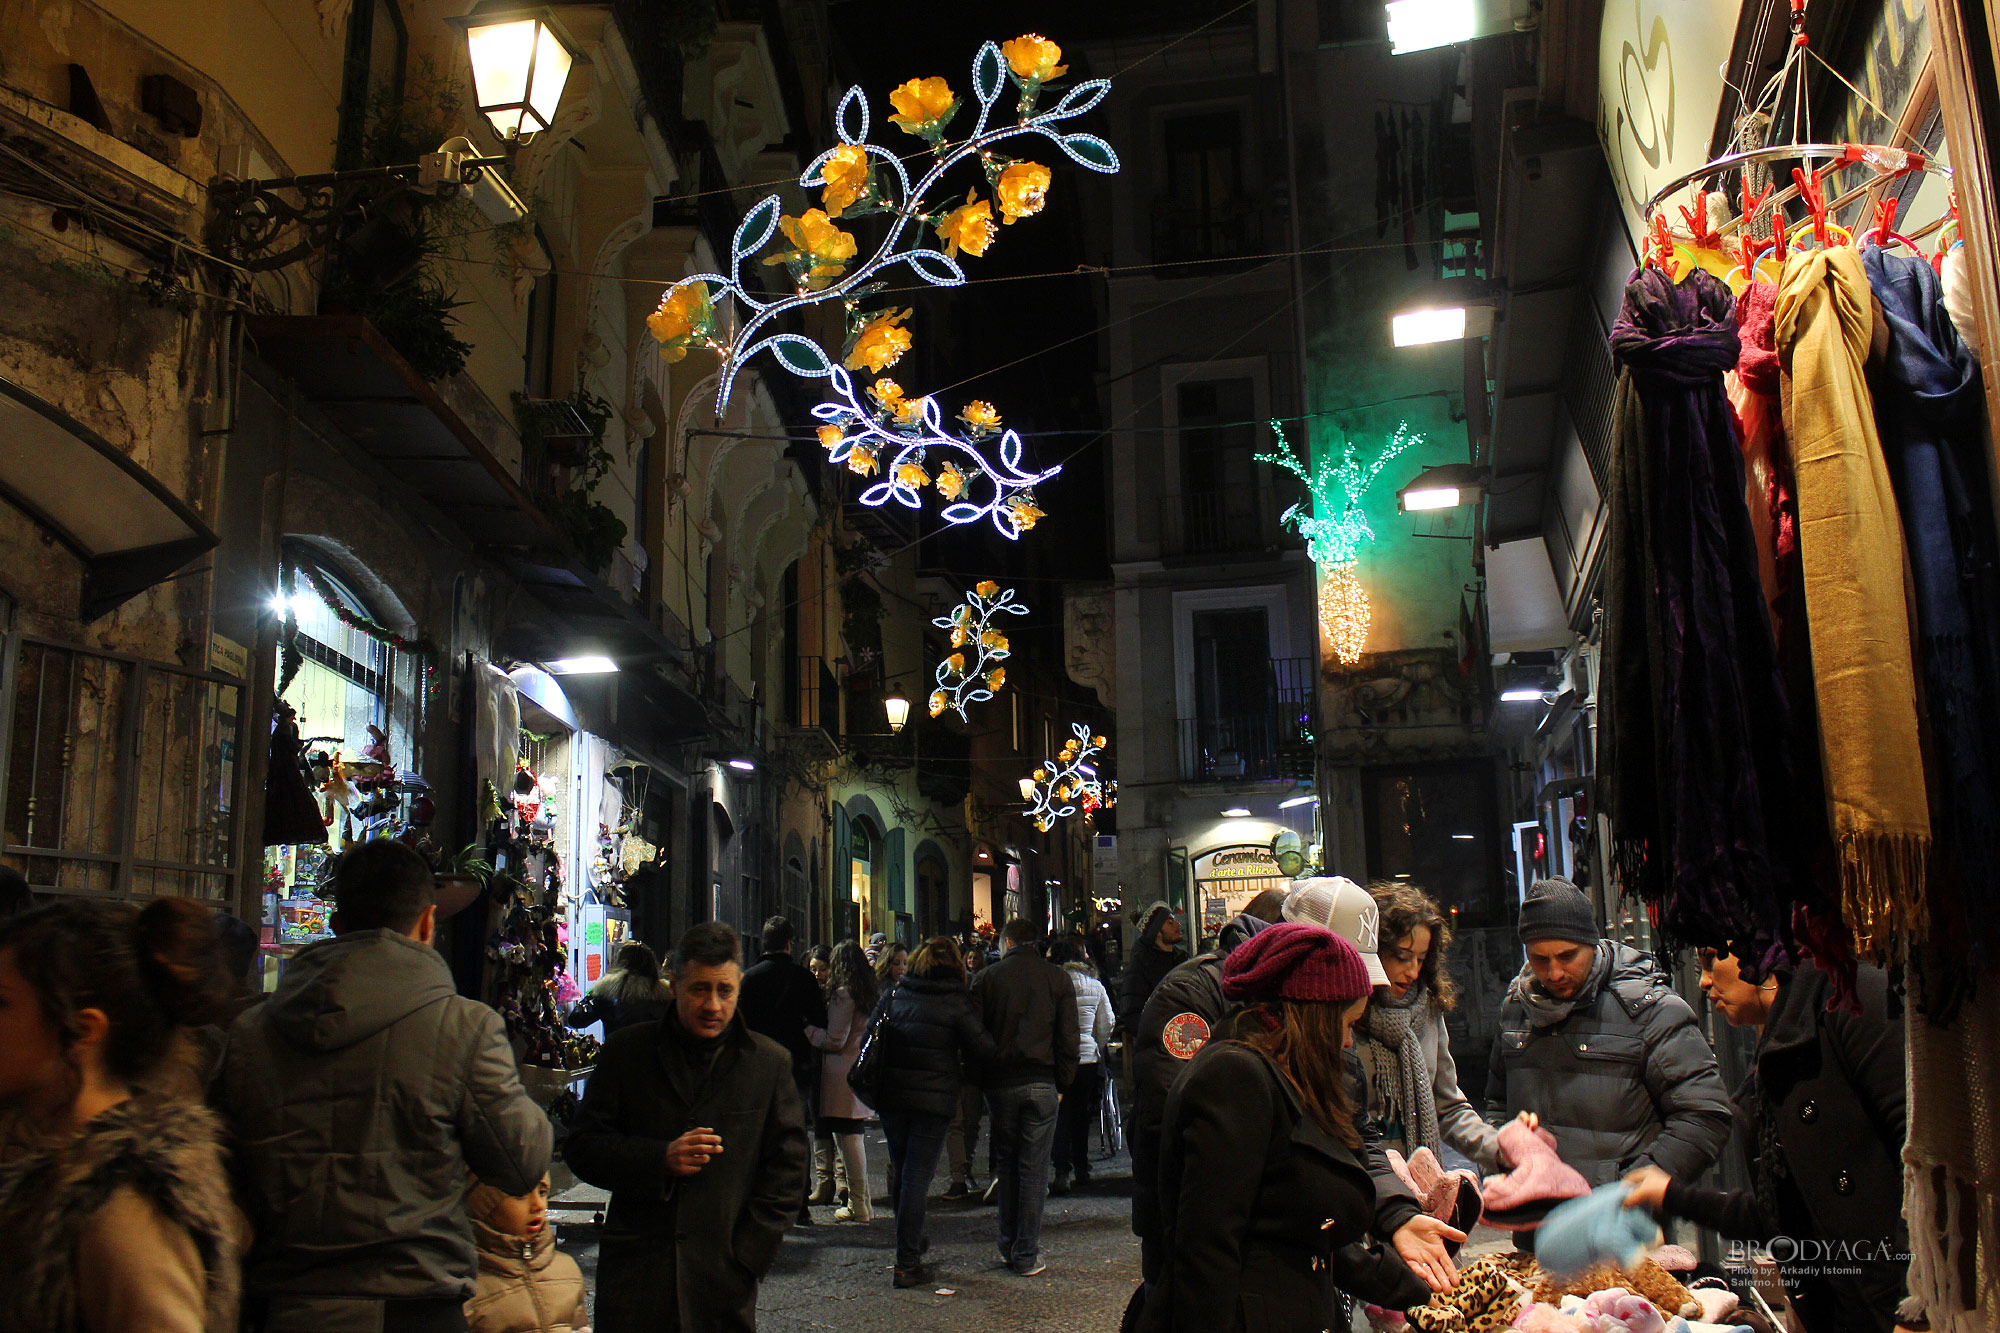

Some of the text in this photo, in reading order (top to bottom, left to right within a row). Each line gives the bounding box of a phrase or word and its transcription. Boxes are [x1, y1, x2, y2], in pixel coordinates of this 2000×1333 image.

[1212, 849, 1273, 867] Ceramica
[1209, 864, 1277, 878] d'arte a Rilievo
[1357, 907, 1379, 949] NY
